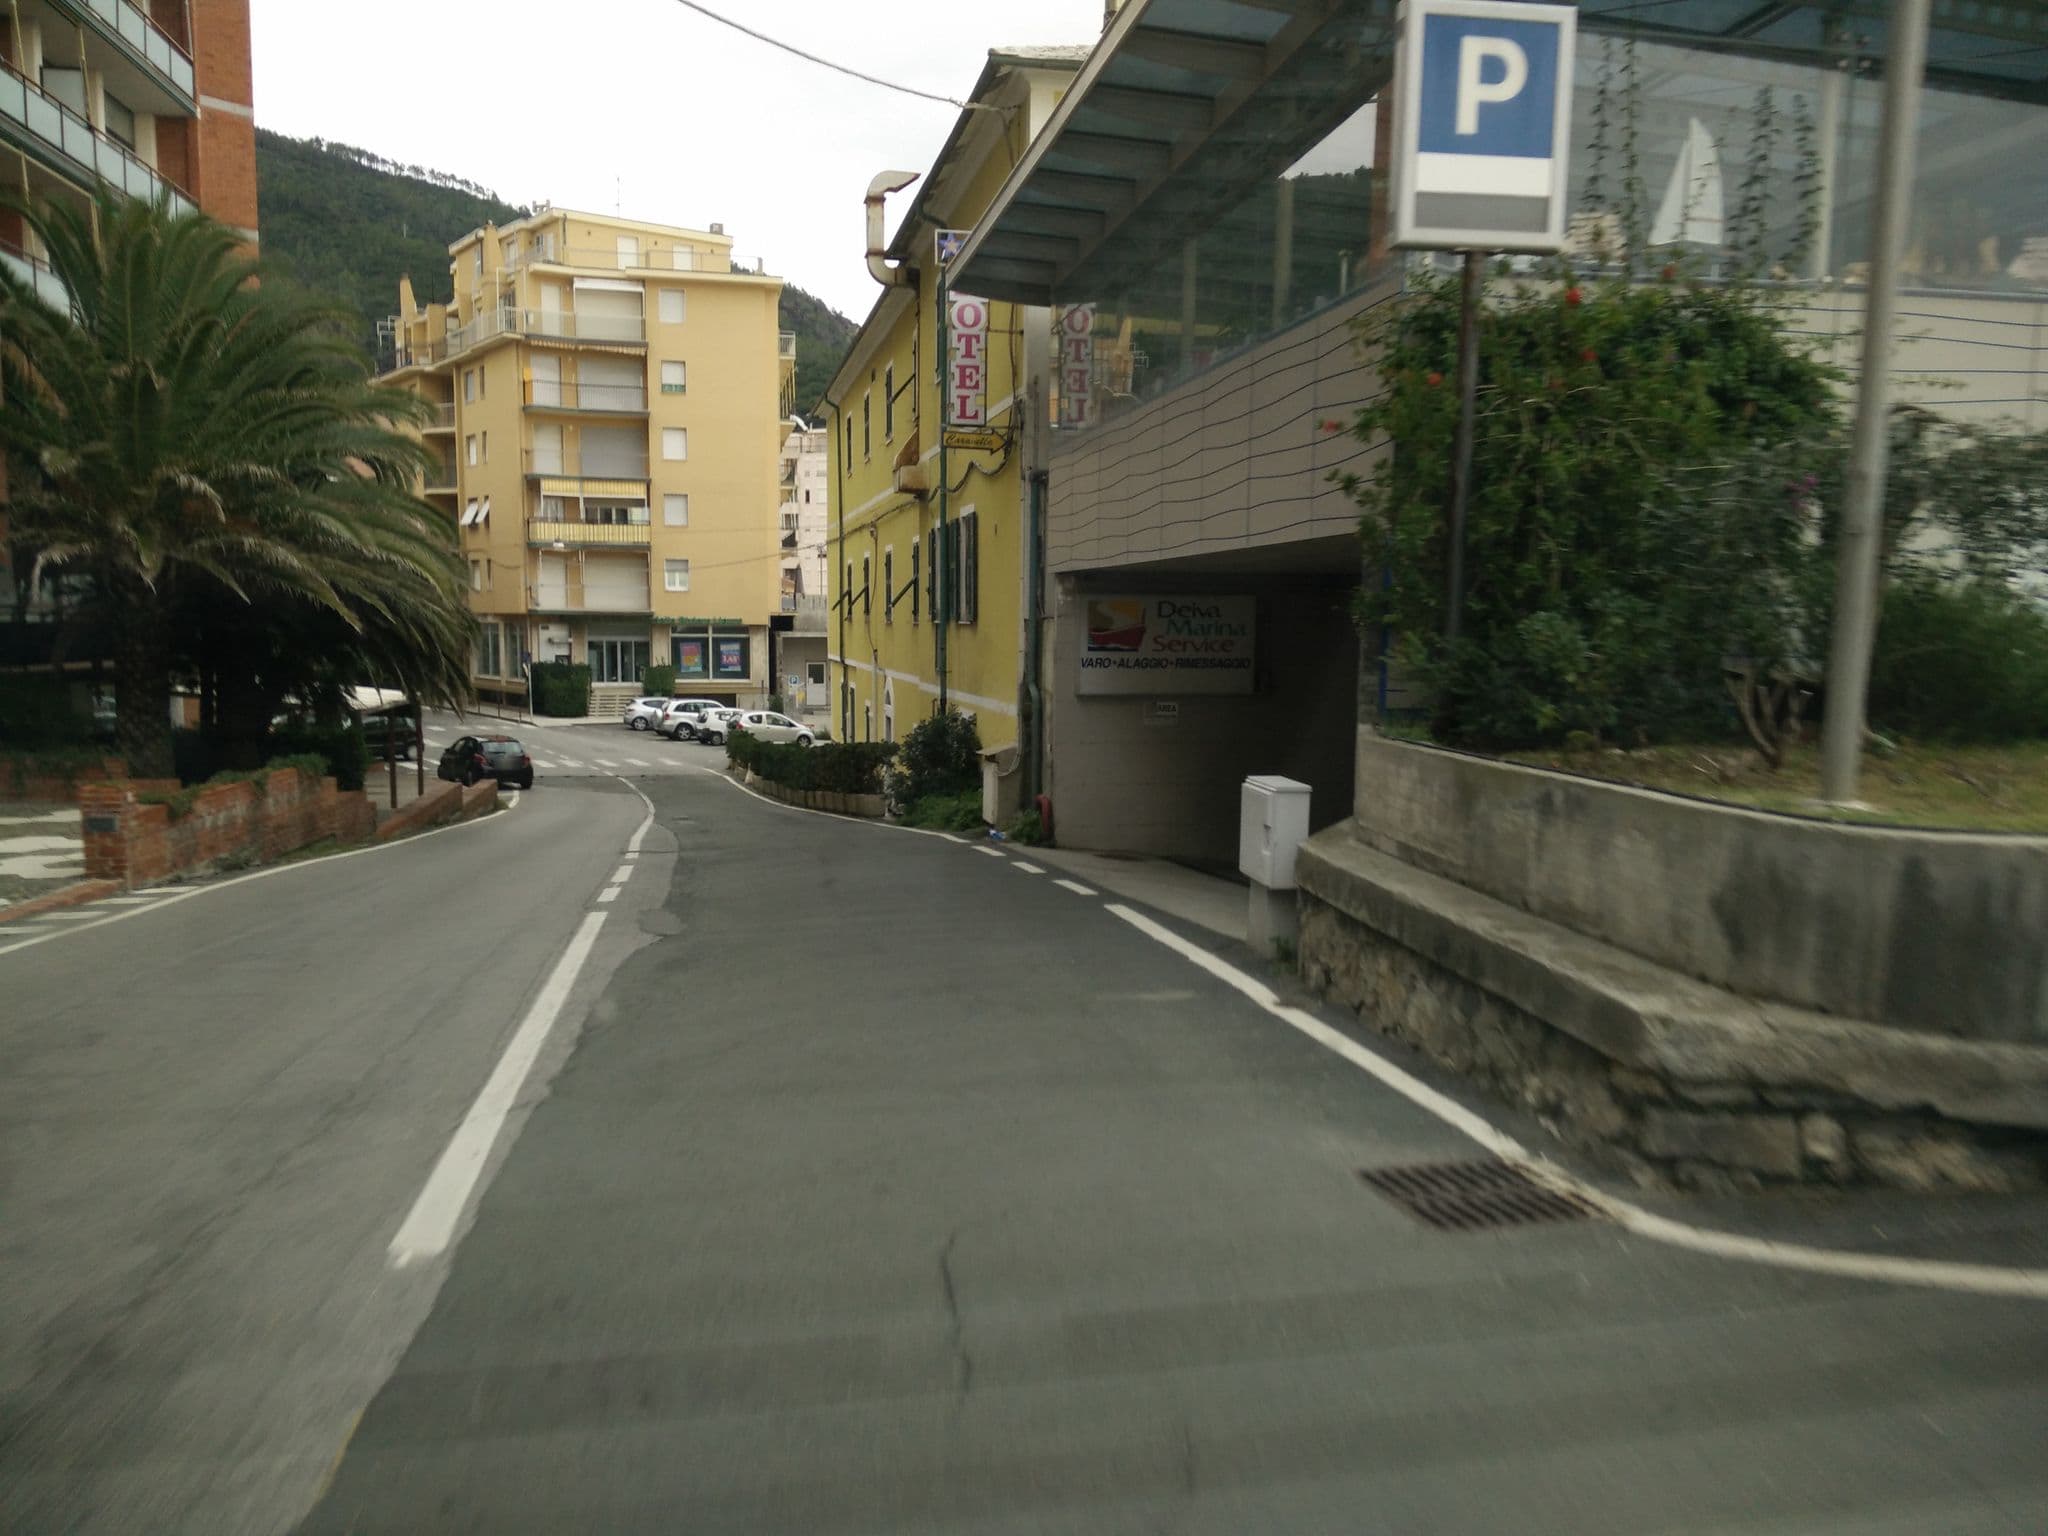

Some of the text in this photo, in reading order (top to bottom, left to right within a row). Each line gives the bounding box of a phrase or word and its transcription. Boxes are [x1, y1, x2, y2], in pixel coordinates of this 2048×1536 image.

[1455, 34, 1528, 136] P
[955, 296, 982, 420] OTEL
[1157, 601, 1222, 619] Deiva
[1166, 620, 1247, 636] Marina
[1152, 635, 1234, 652] Service
